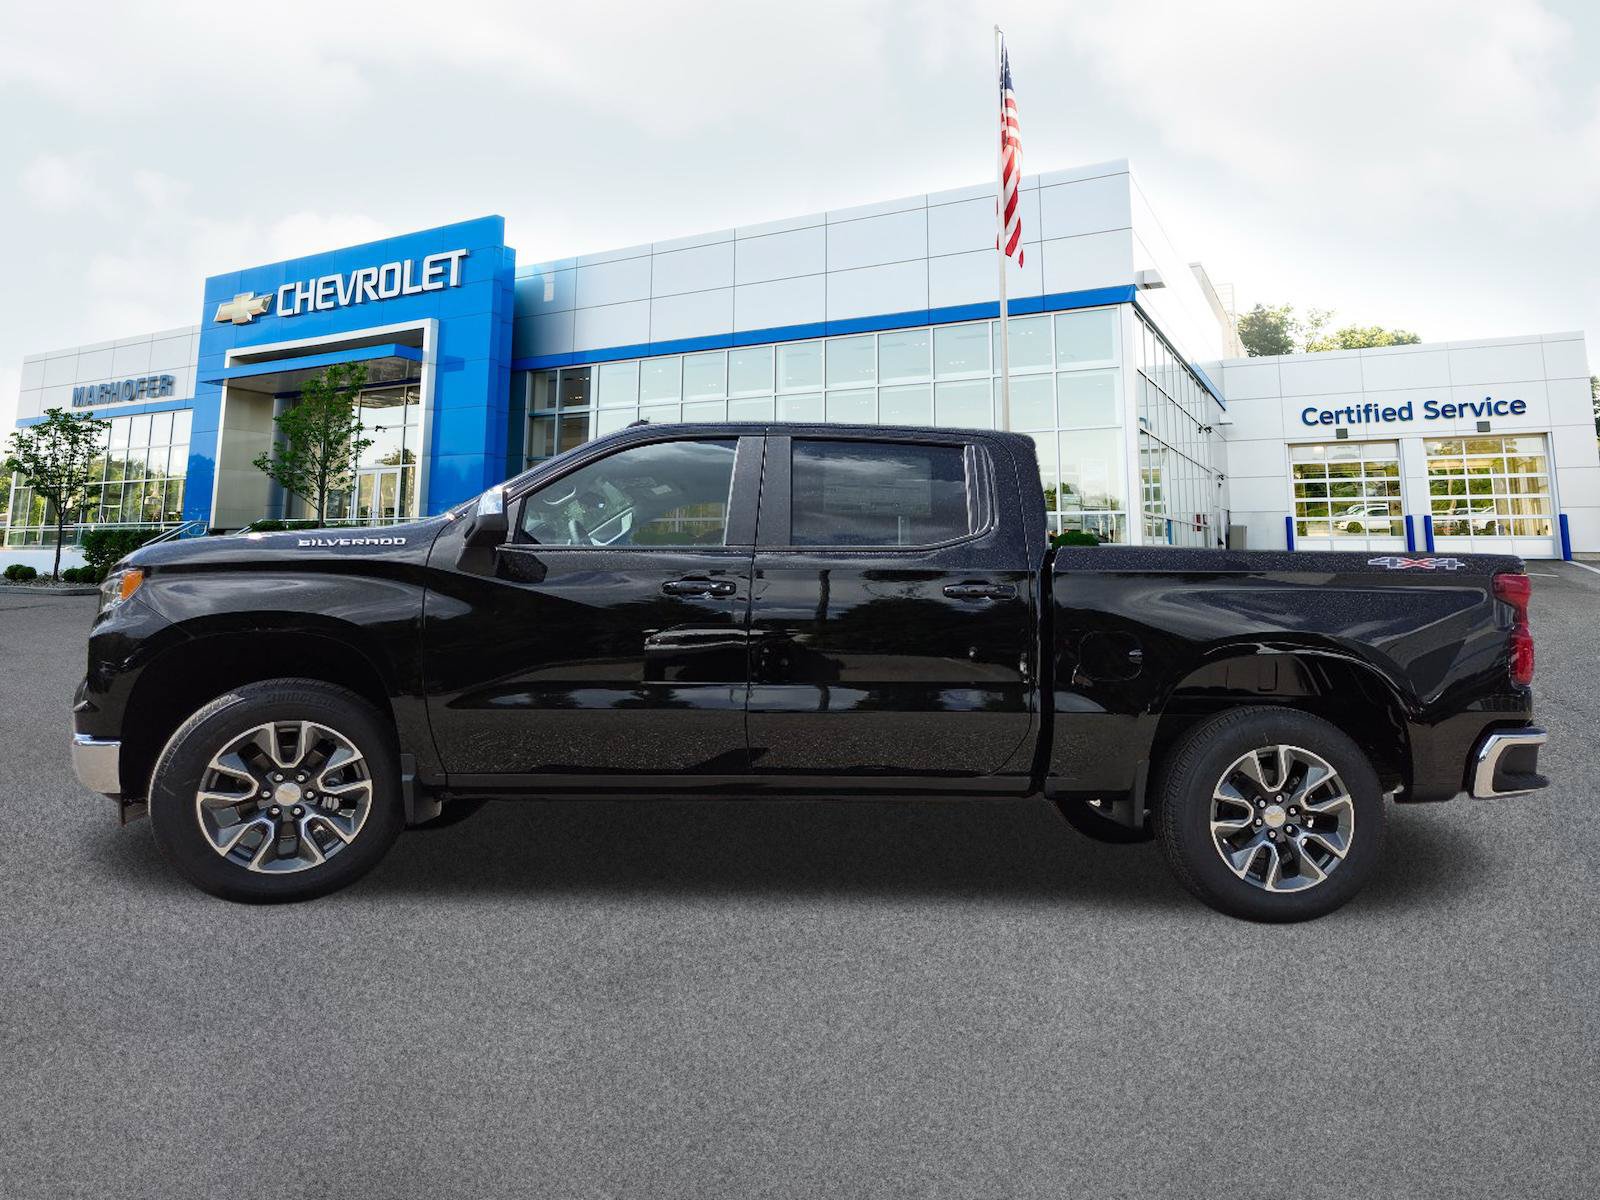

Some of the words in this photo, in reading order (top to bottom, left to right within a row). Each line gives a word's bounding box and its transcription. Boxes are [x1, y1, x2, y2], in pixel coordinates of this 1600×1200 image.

[276, 248, 470, 317] CHEVROLET
[72, 374, 176, 407] MARHOFER
[1302, 401, 1414, 427] Certified
[1423, 397, 1527, 420] Service
[297, 536, 407, 547] SILVERADO
